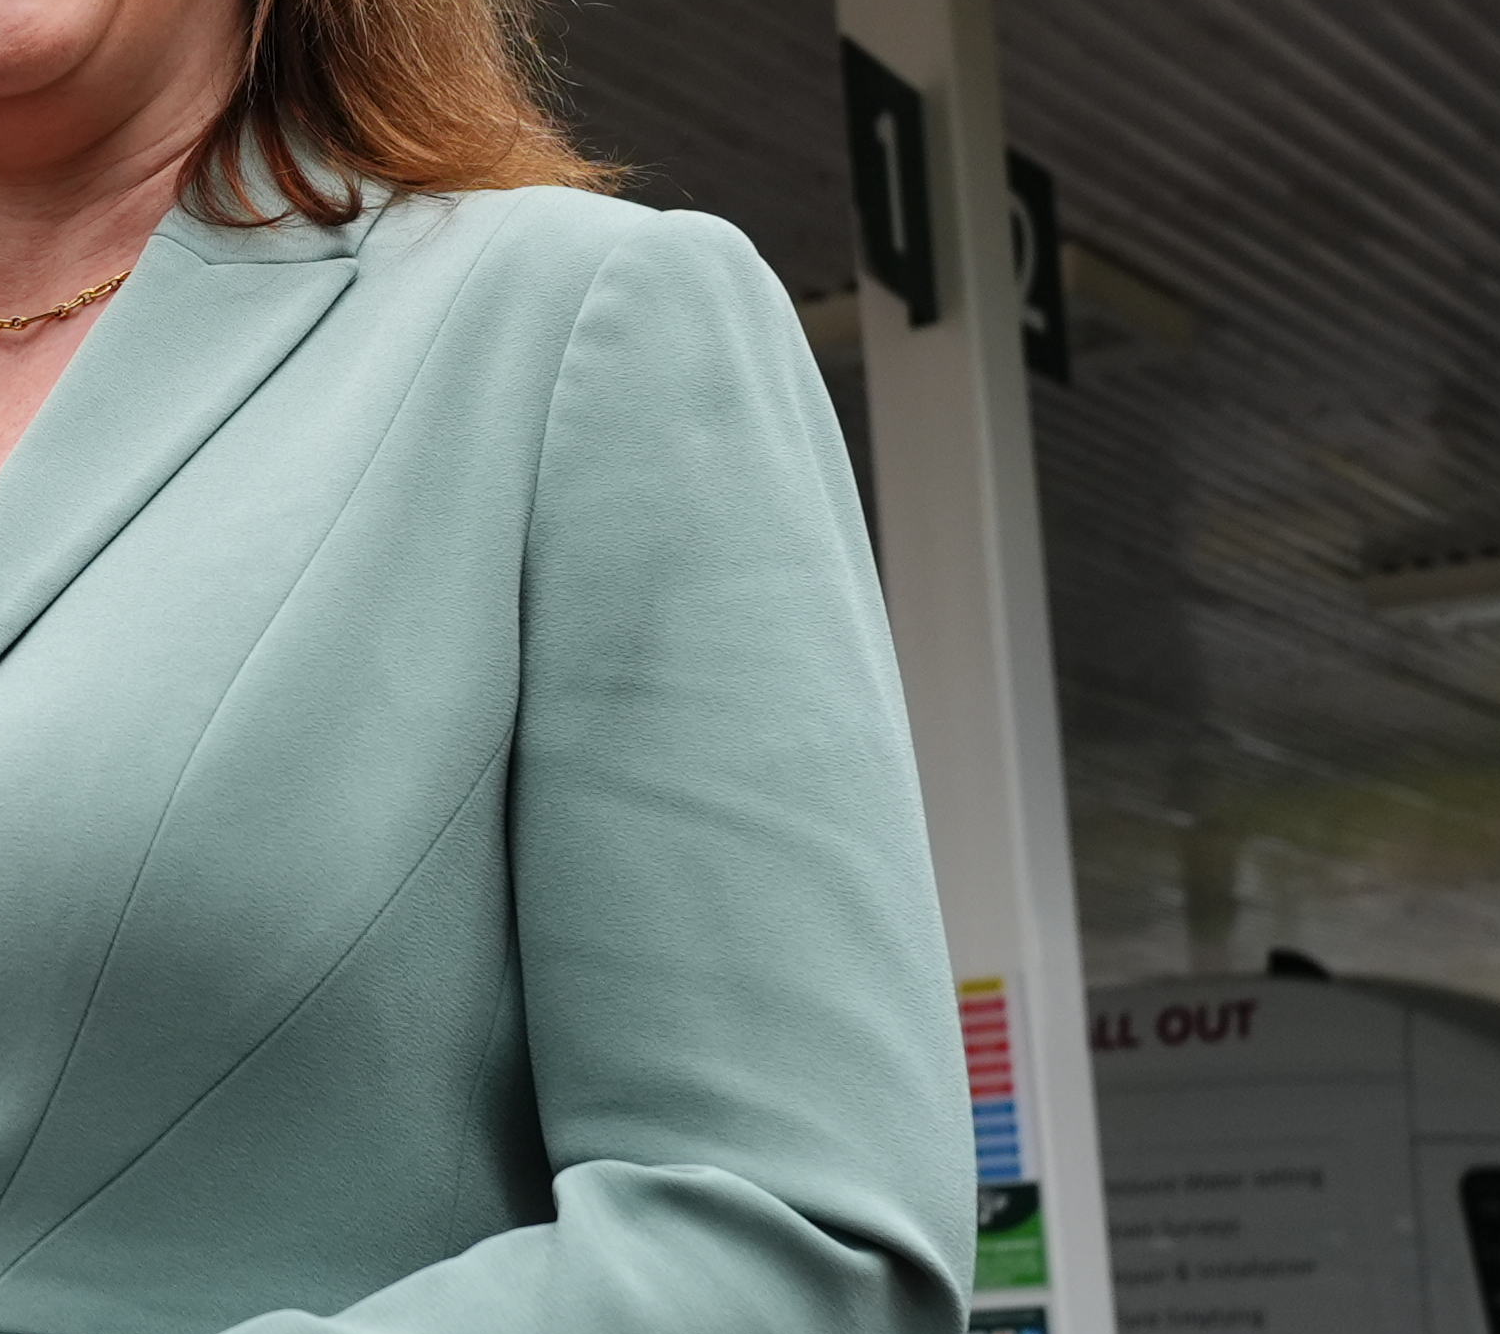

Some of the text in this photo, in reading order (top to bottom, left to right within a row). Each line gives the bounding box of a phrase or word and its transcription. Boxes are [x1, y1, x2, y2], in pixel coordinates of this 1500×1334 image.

[873, 110, 908, 257] 1
[1091, 997, 1259, 1051] LL OUT
